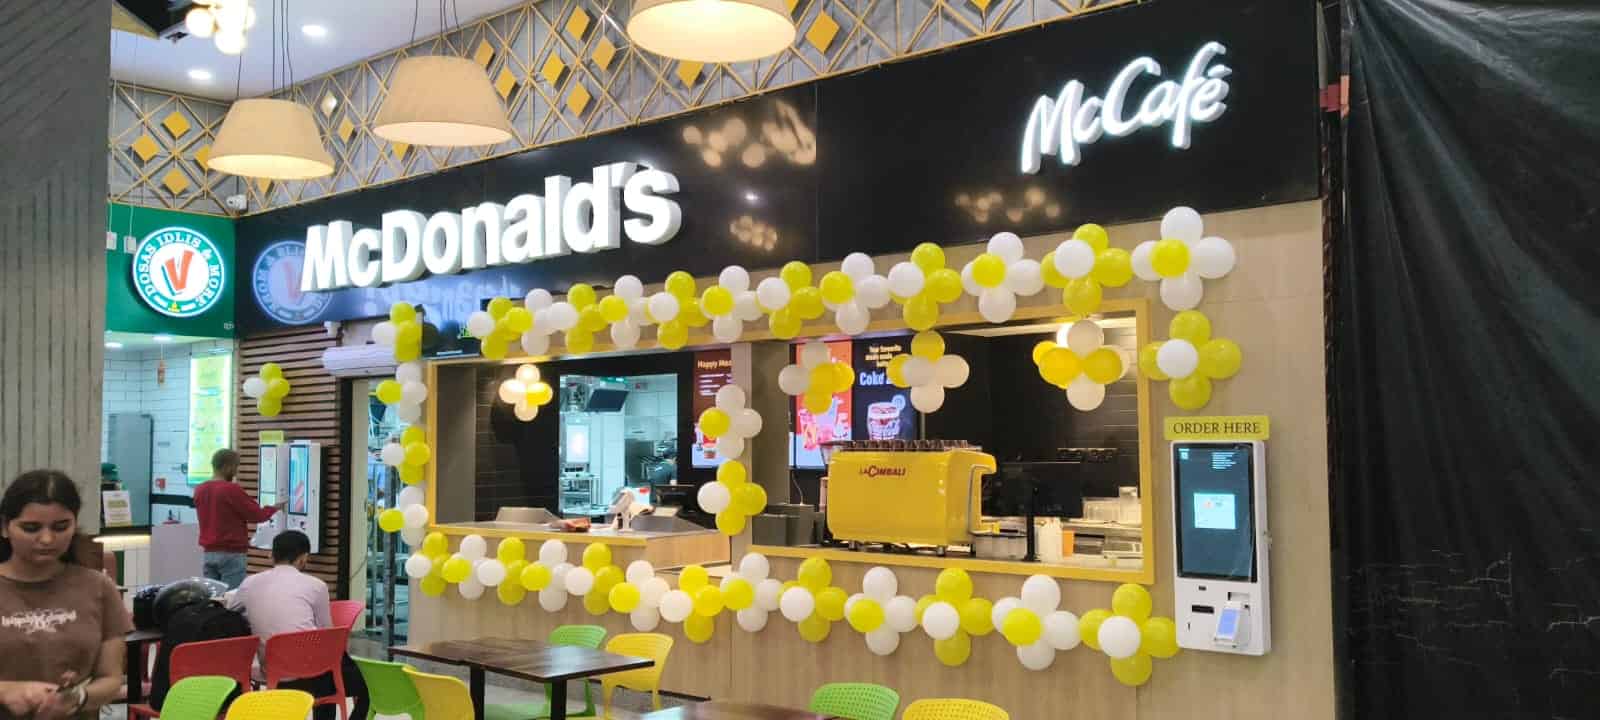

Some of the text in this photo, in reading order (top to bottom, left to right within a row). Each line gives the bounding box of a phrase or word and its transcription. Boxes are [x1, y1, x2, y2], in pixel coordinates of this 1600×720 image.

[1021, 41, 1232, 175] McCafé
[138, 243, 157, 297] DOSAS
[156, 231, 202, 249] IDLIS
[196, 263, 220, 307] MORE
[301, 161, 682, 291] McDonald's
[1173, 421, 1262, 434] ORDER HERE
